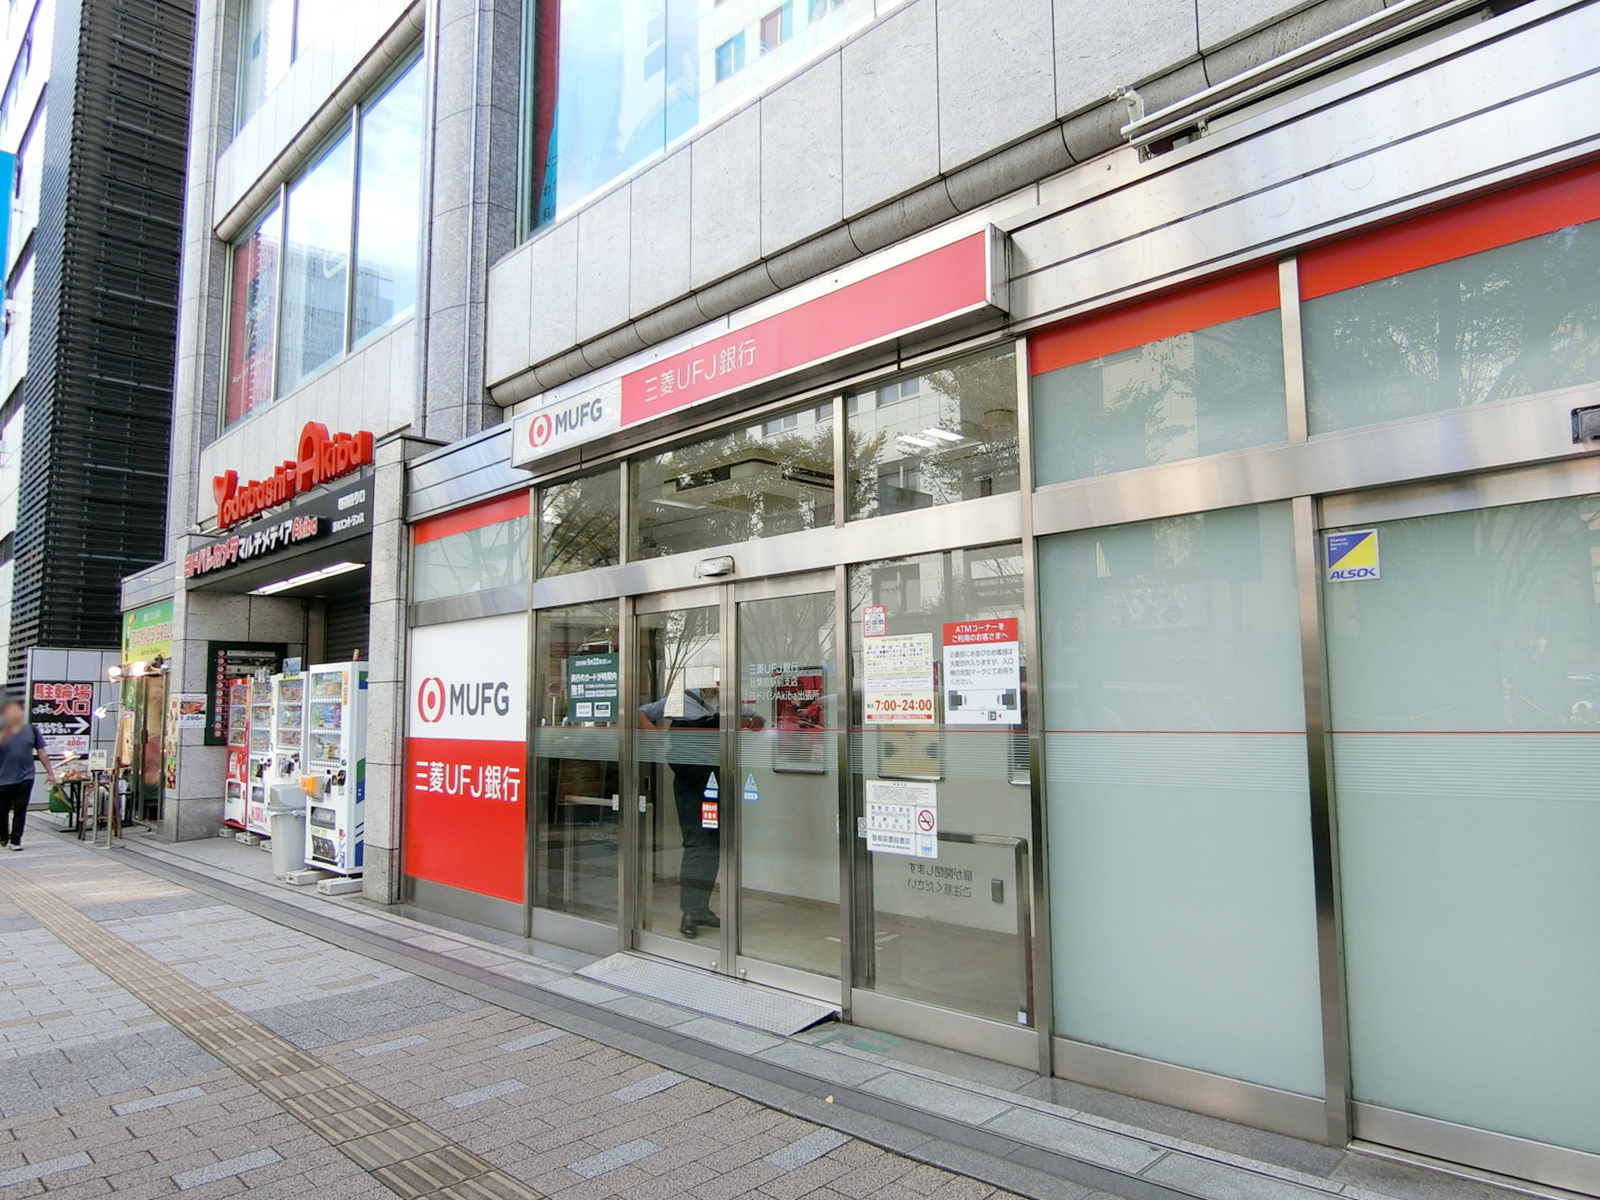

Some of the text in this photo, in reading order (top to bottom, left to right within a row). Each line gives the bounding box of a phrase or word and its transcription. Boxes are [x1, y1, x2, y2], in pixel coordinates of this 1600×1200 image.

[644, 338, 756, 403] 三菱UFJ銀行
[554, 398, 602, 435] MUFG
[1330, 568, 1376, 580] ALSOK
[955, 623, 1004, 633] ATMコーナーを
[951, 632, 1009, 643] ご利用のお客さまへ
[33, 683, 93, 700] 駐輪場
[450, 681, 509, 716] MUFG
[53, 699, 91, 715] 入口
[415, 760, 521, 802] 三菱UFJ銀行
